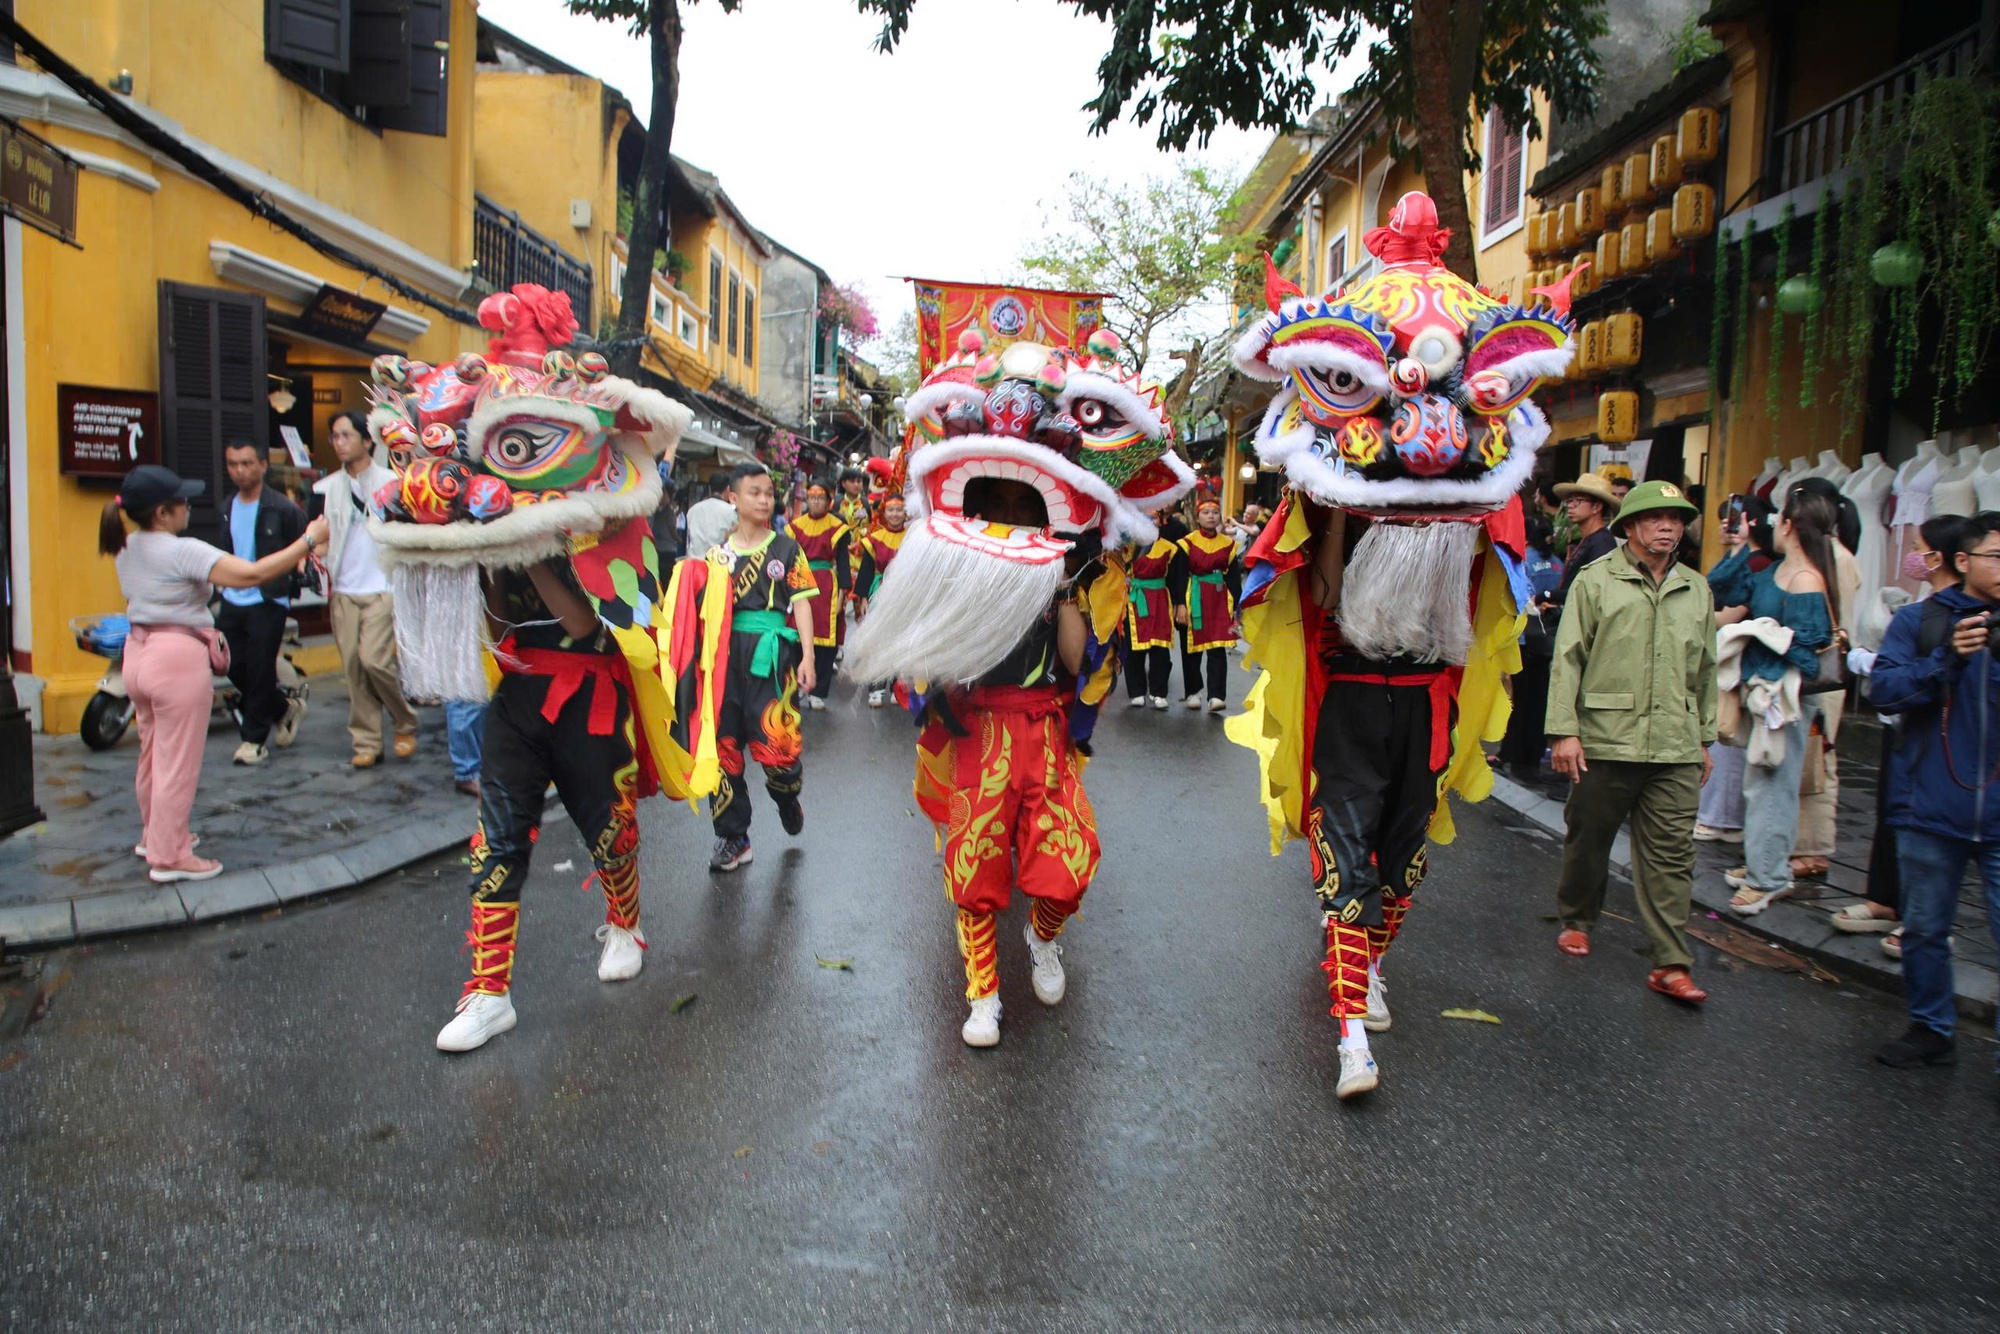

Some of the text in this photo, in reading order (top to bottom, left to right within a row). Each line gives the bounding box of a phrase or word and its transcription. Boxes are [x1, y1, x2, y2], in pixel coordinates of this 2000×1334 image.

[1588, 329, 1596, 362] SASA
[73, 402, 142, 418] AIR CONDITIONED
[1607, 400, 1615, 434] SASA
[107, 415, 128, 426] AREA
[95, 425, 120, 437] FLOOR
